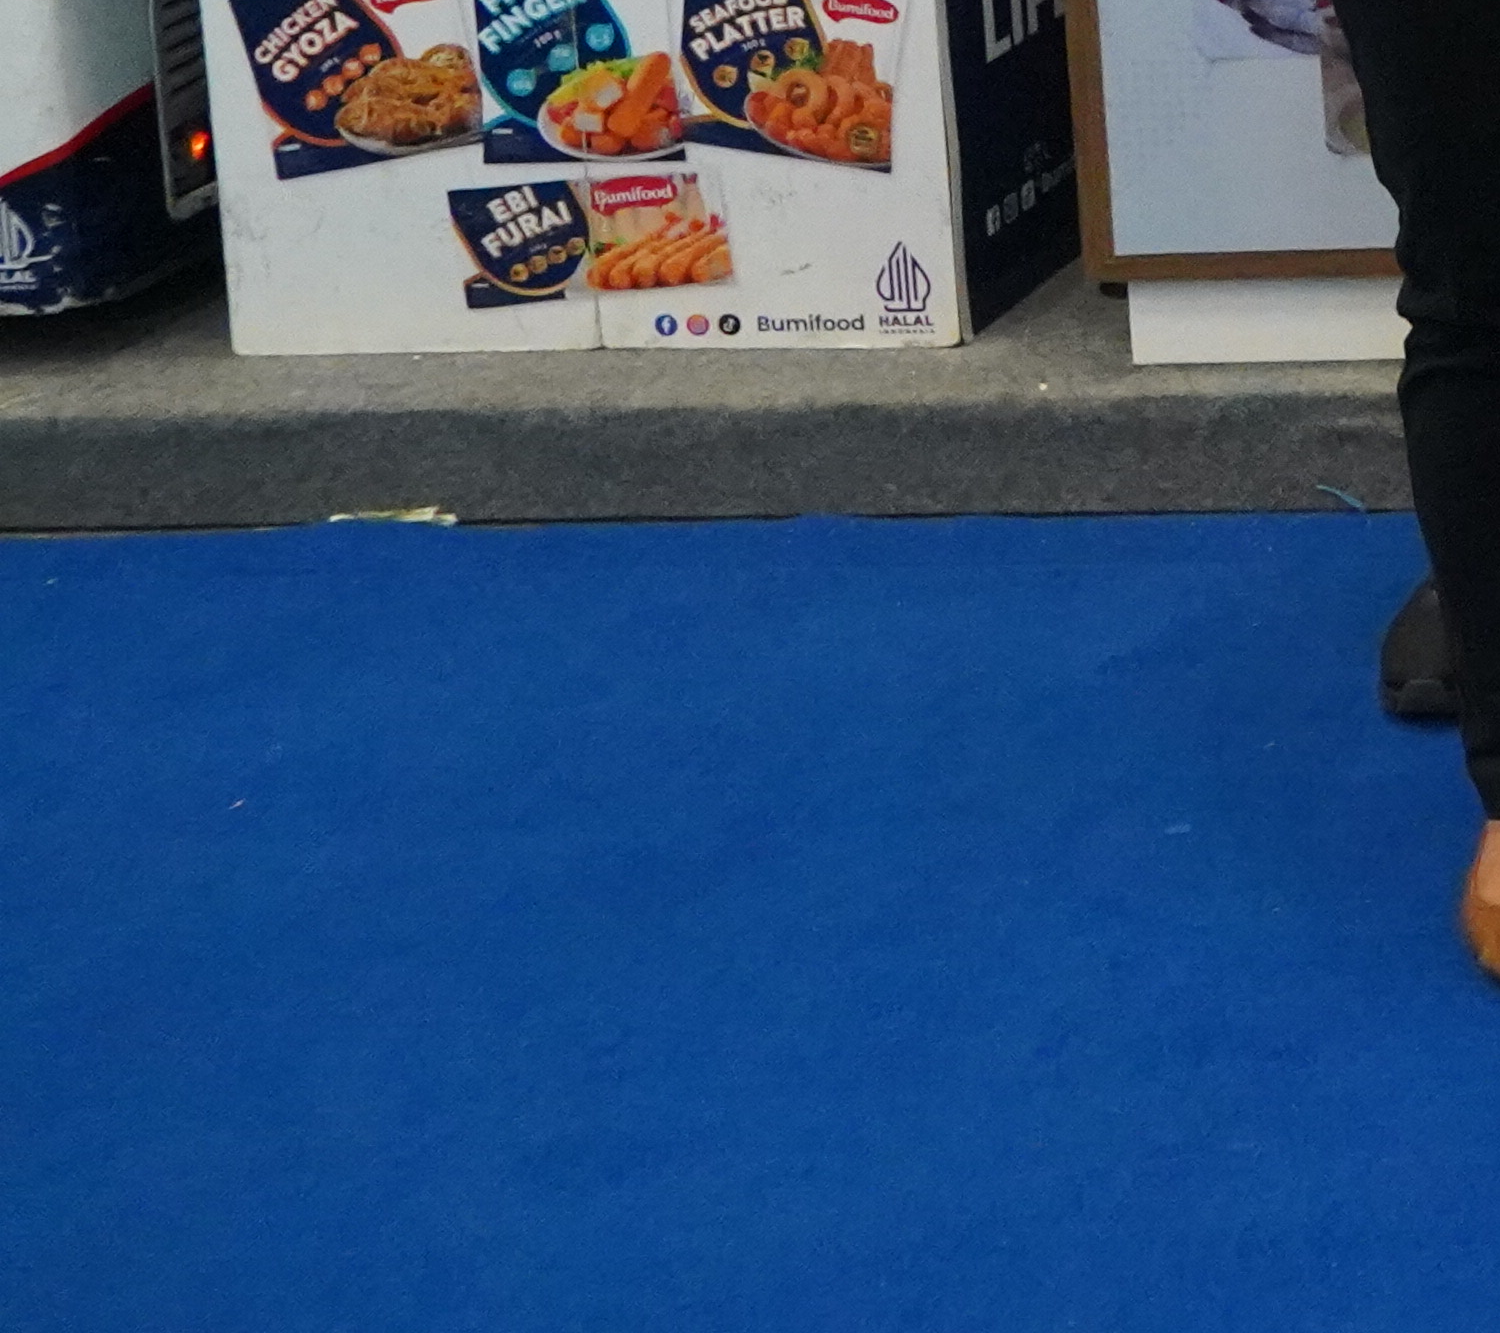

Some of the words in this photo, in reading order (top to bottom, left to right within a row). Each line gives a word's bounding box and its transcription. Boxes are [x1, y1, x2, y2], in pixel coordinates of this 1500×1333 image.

[271, 10, 360, 83] GYOZA
[690, 6, 806, 61] PLATTER
[486, 185, 538, 224] EBI
[480, 200, 573, 259] FURAI
[757, 314, 865, 332] Bumifood
[879, 315, 935, 327] HALAL
